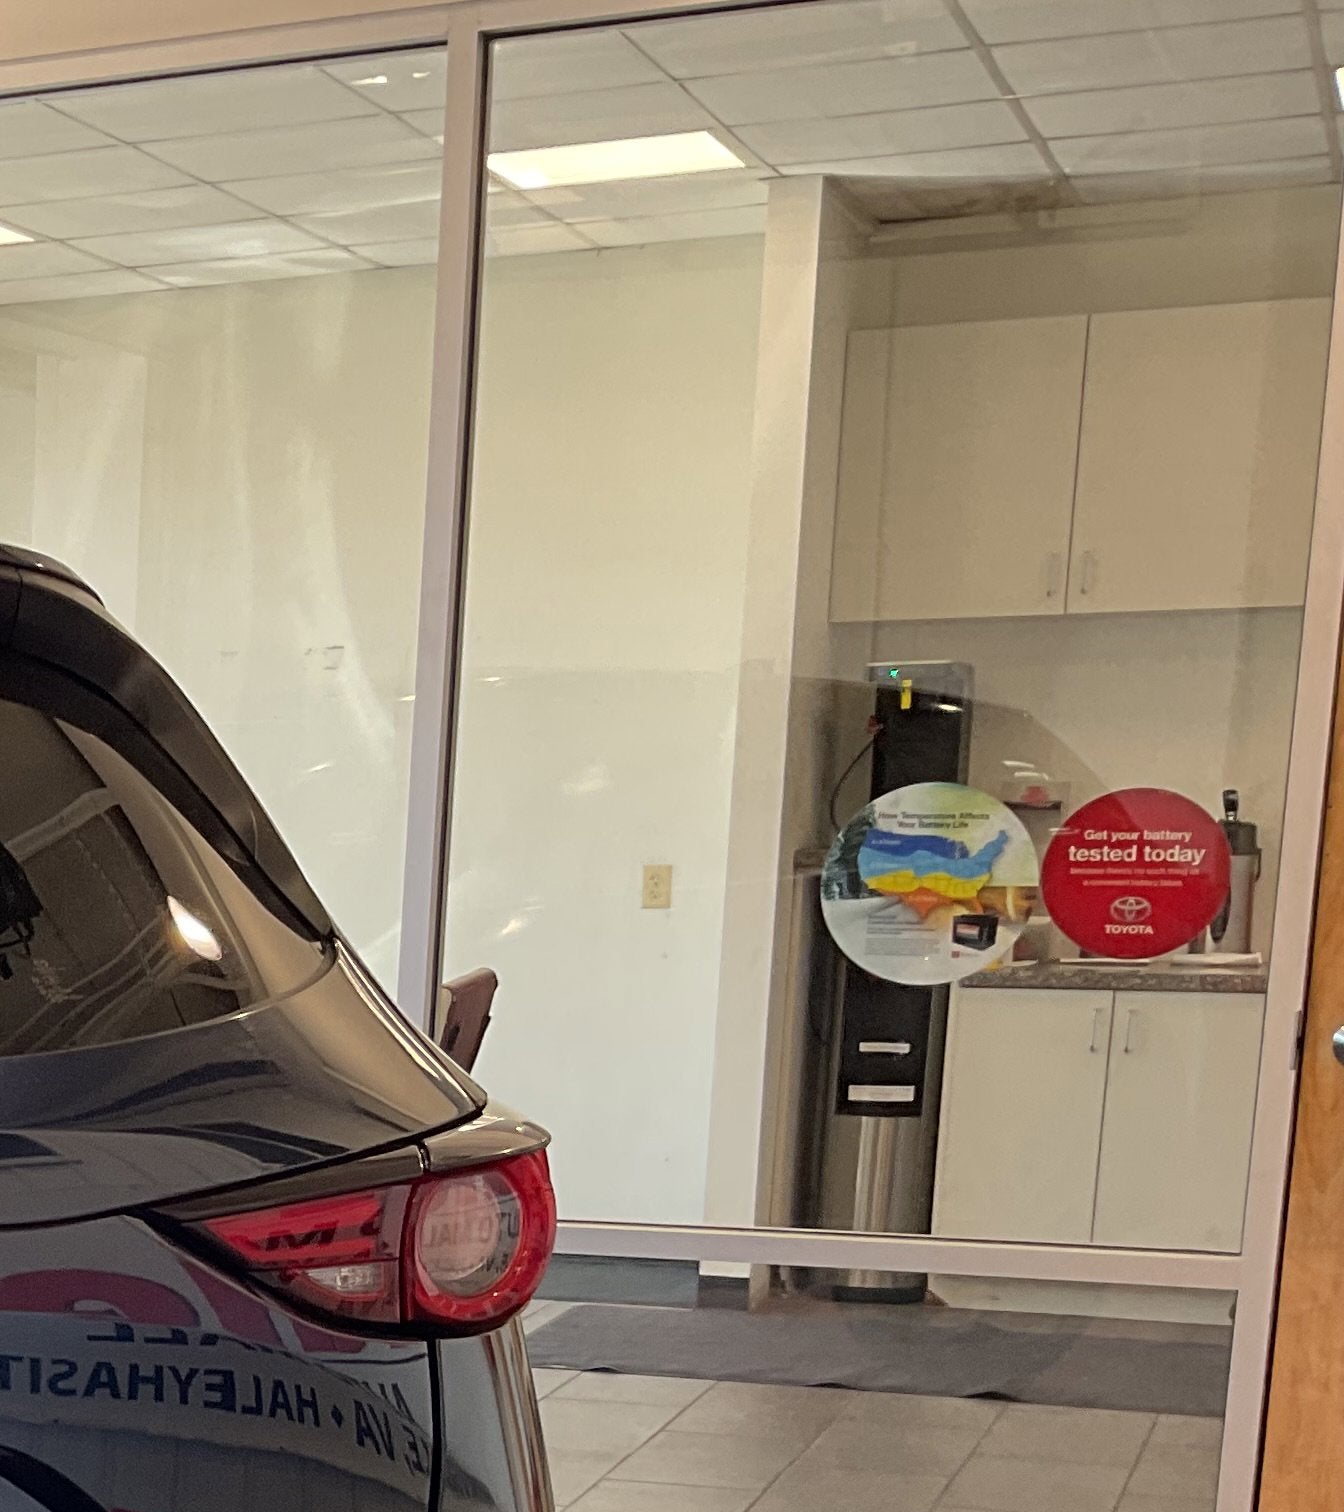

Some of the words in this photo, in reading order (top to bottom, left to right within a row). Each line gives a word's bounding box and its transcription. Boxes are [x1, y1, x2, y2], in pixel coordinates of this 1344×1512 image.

[1083, 830, 1108, 841] Get
[1111, 831, 1141, 843] your
[1143, 829, 1192, 843] battery
[1068, 845, 1138, 863] tested
[1143, 845, 1206, 866] today
[1104, 924, 1154, 935] TOYOTA
